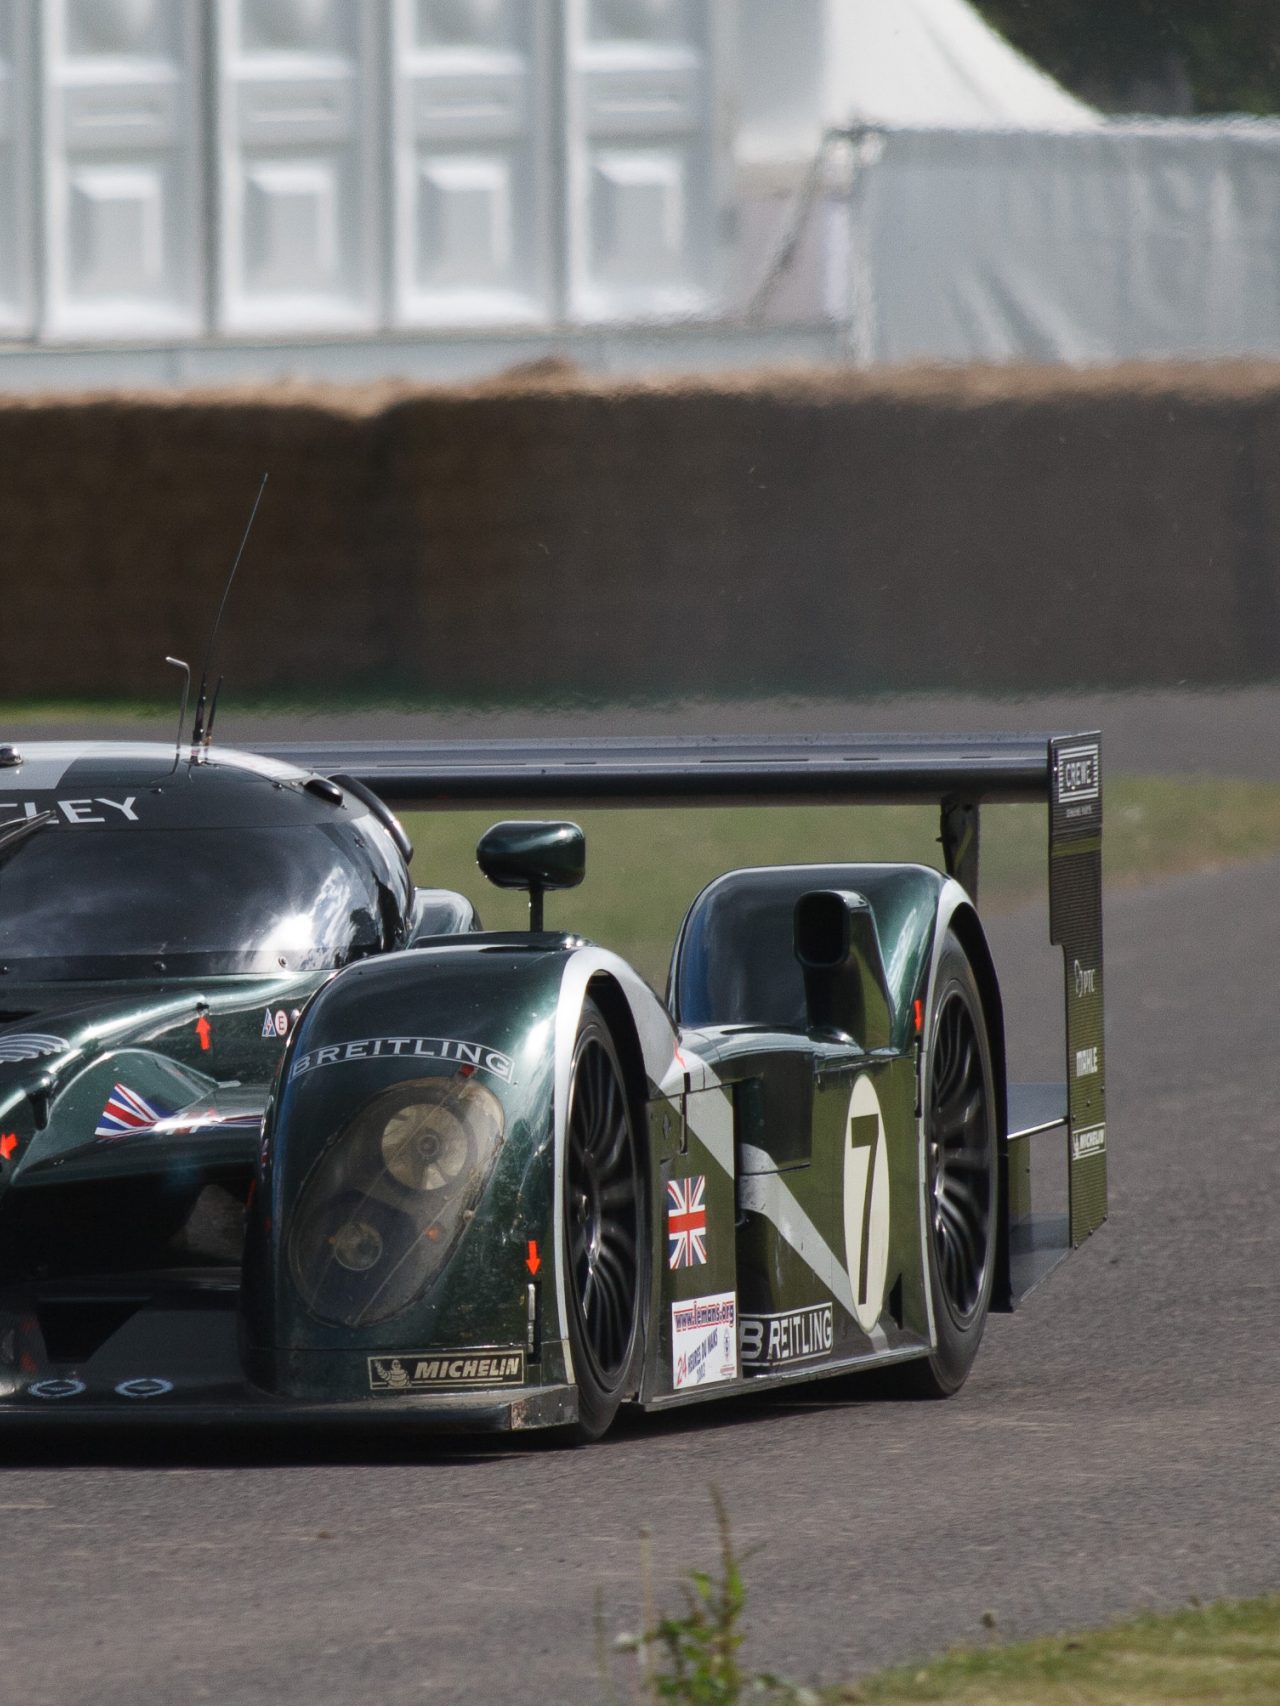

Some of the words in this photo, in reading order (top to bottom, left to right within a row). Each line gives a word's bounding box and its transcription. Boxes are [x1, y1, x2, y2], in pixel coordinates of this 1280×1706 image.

[292, 1039, 511, 1077] BREITLING
[851, 1113, 879, 1305] 7
[675, 1301, 734, 1329] www.lemans.org
[740, 1309, 832, 1360] BREITLING
[414, 1358, 519, 1379] MICHELIN
